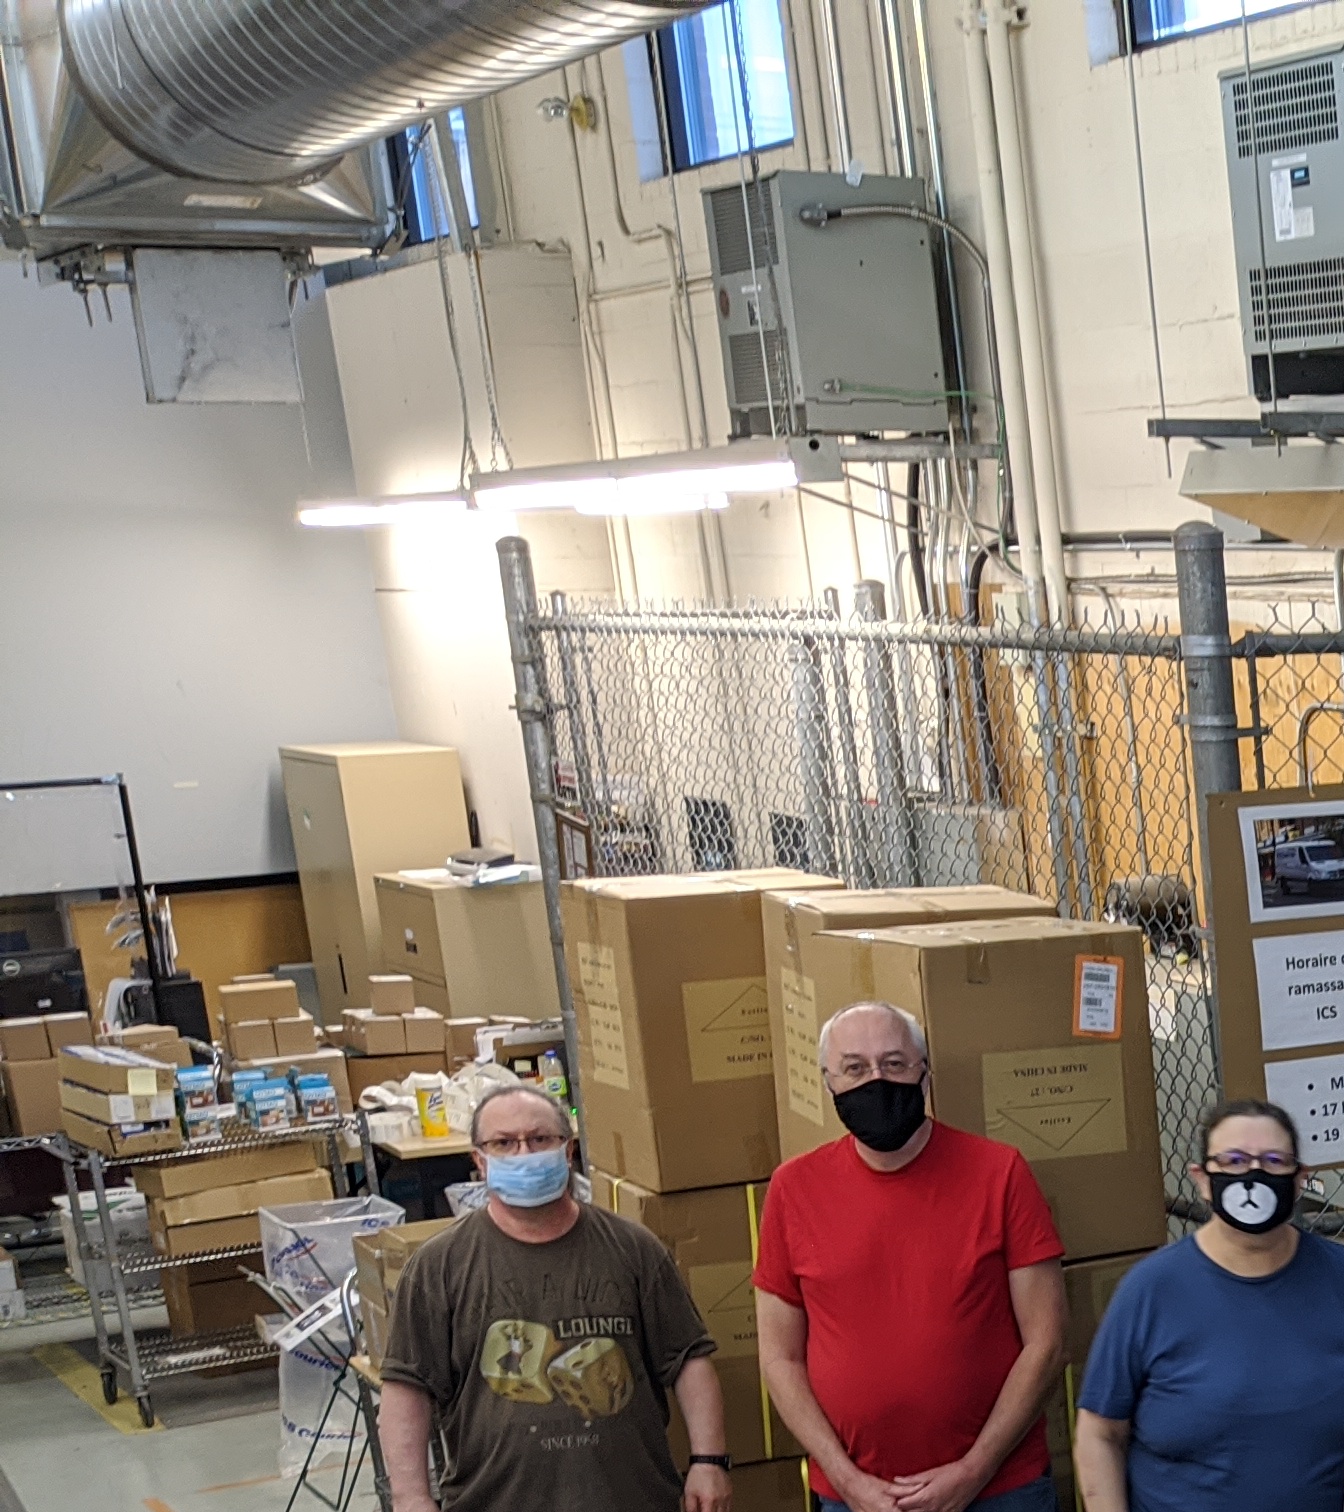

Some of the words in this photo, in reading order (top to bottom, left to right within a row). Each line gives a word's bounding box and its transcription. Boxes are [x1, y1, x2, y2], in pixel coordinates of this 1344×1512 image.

[1285, 953, 1337, 970] Horaire
[1316, 1005, 1338, 1020] ICS
[1013, 1067, 1045, 1078] CHINA
[1047, 1066, 1057, 1075] IN
[1060, 1064, 1088, 1075] MADE
[1322, 1102, 1338, 1117] 17
[1324, 1127, 1340, 1142] 19
[540, 1434, 573, 1451] SINCE
